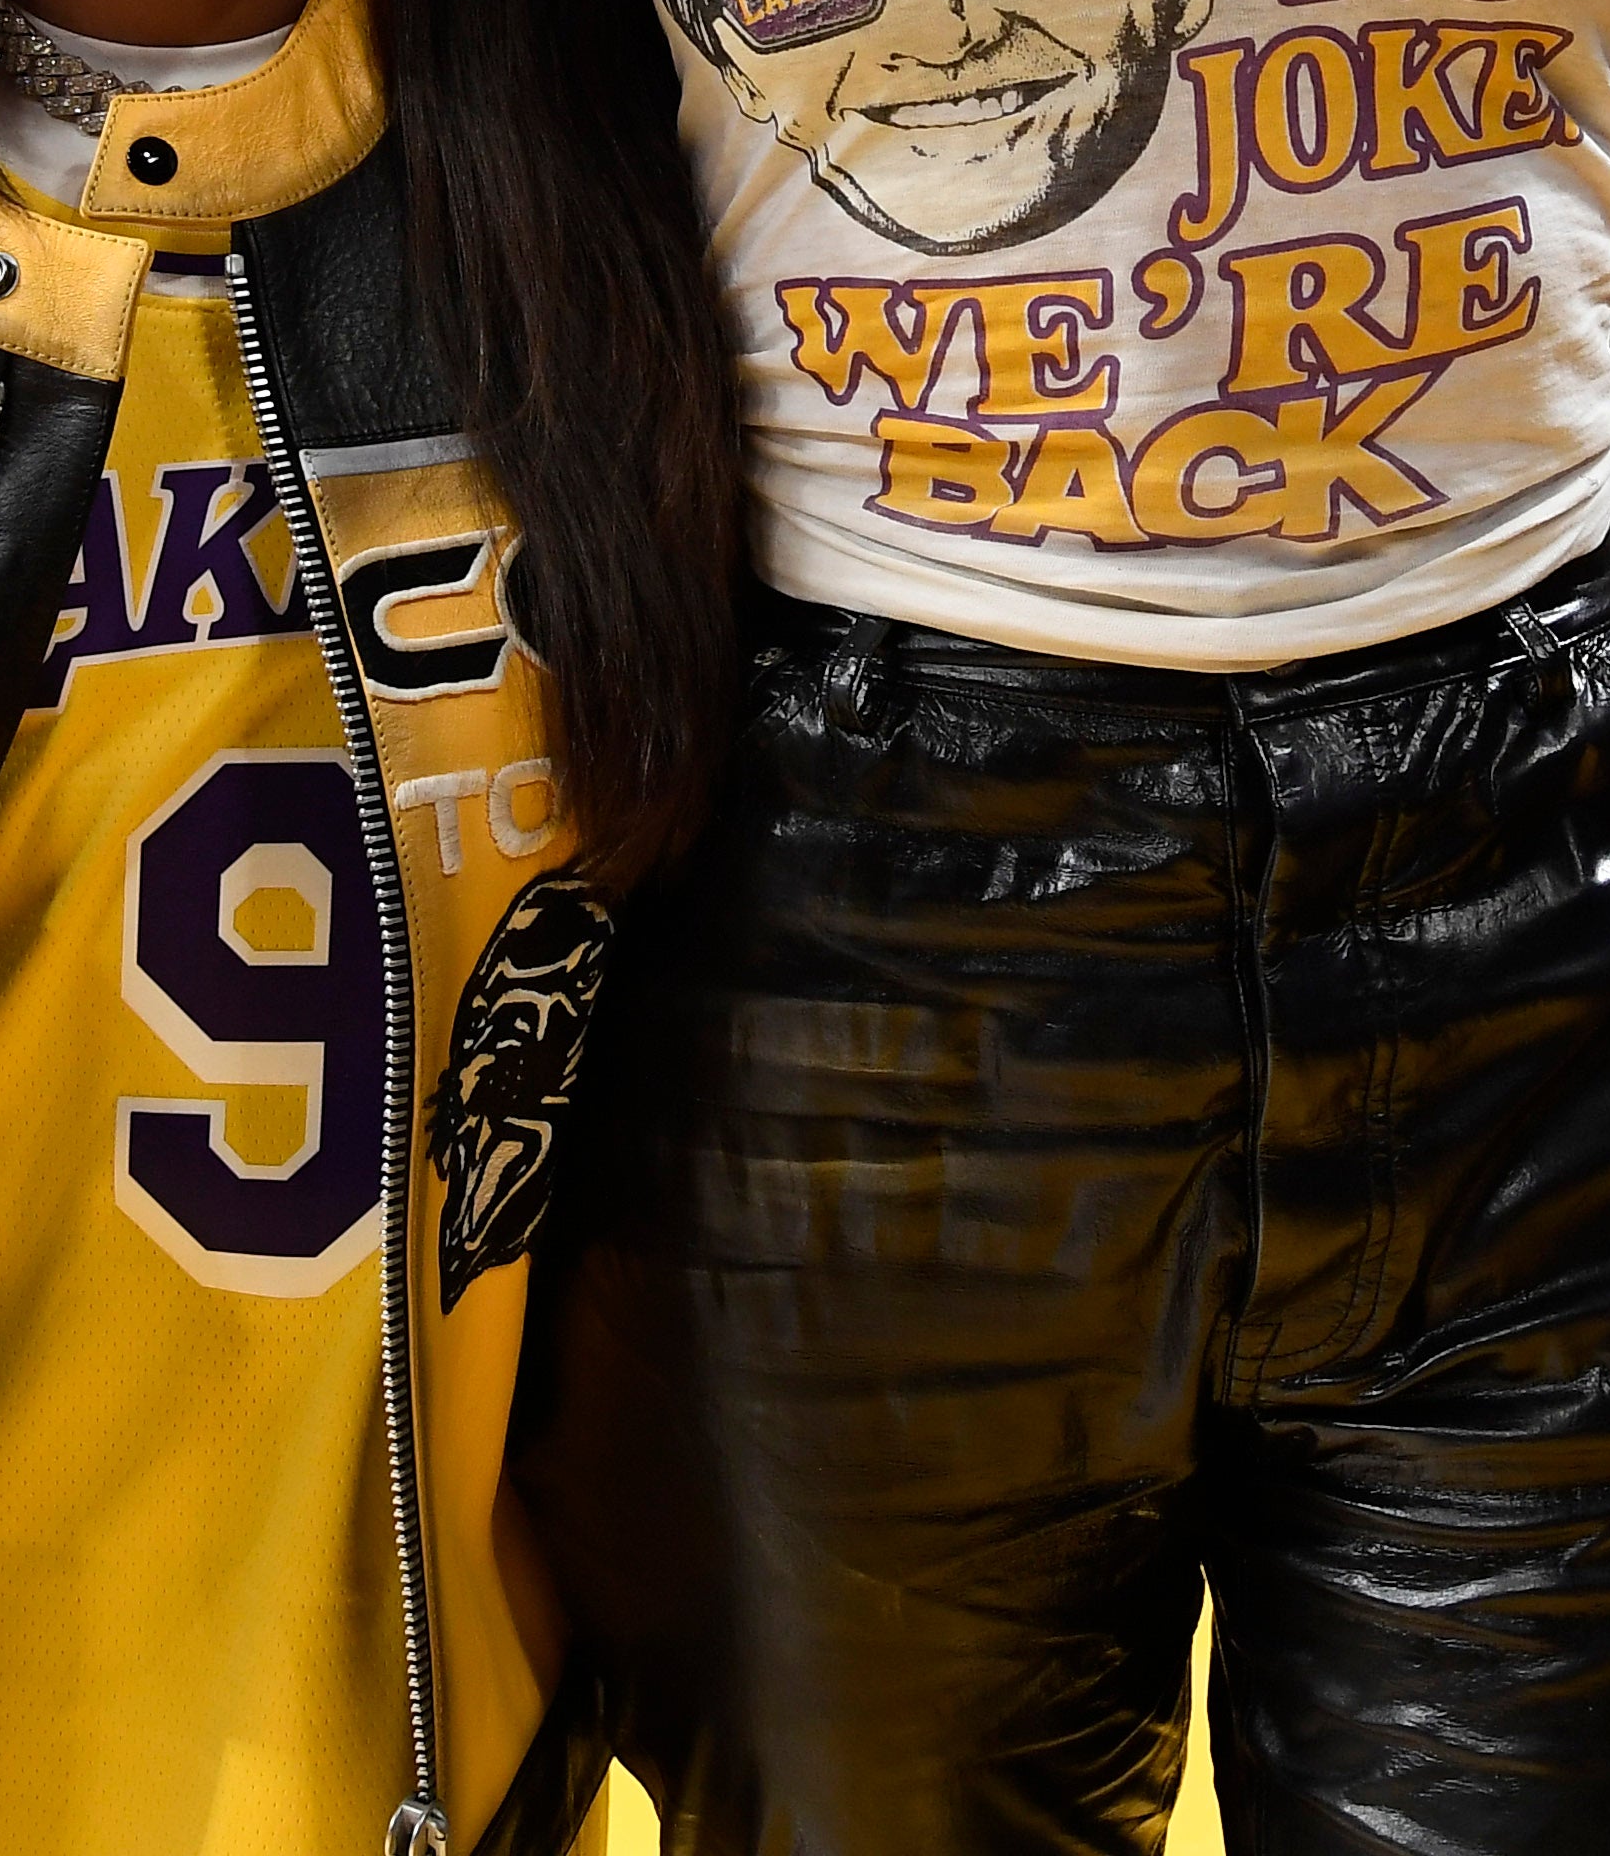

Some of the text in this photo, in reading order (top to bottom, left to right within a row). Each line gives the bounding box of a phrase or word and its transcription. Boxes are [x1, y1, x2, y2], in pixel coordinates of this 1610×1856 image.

[774, 195, 1541, 428] WE'RE
[865, 370, 1450, 553] BACK
[114, 747, 388, 1298] 9
